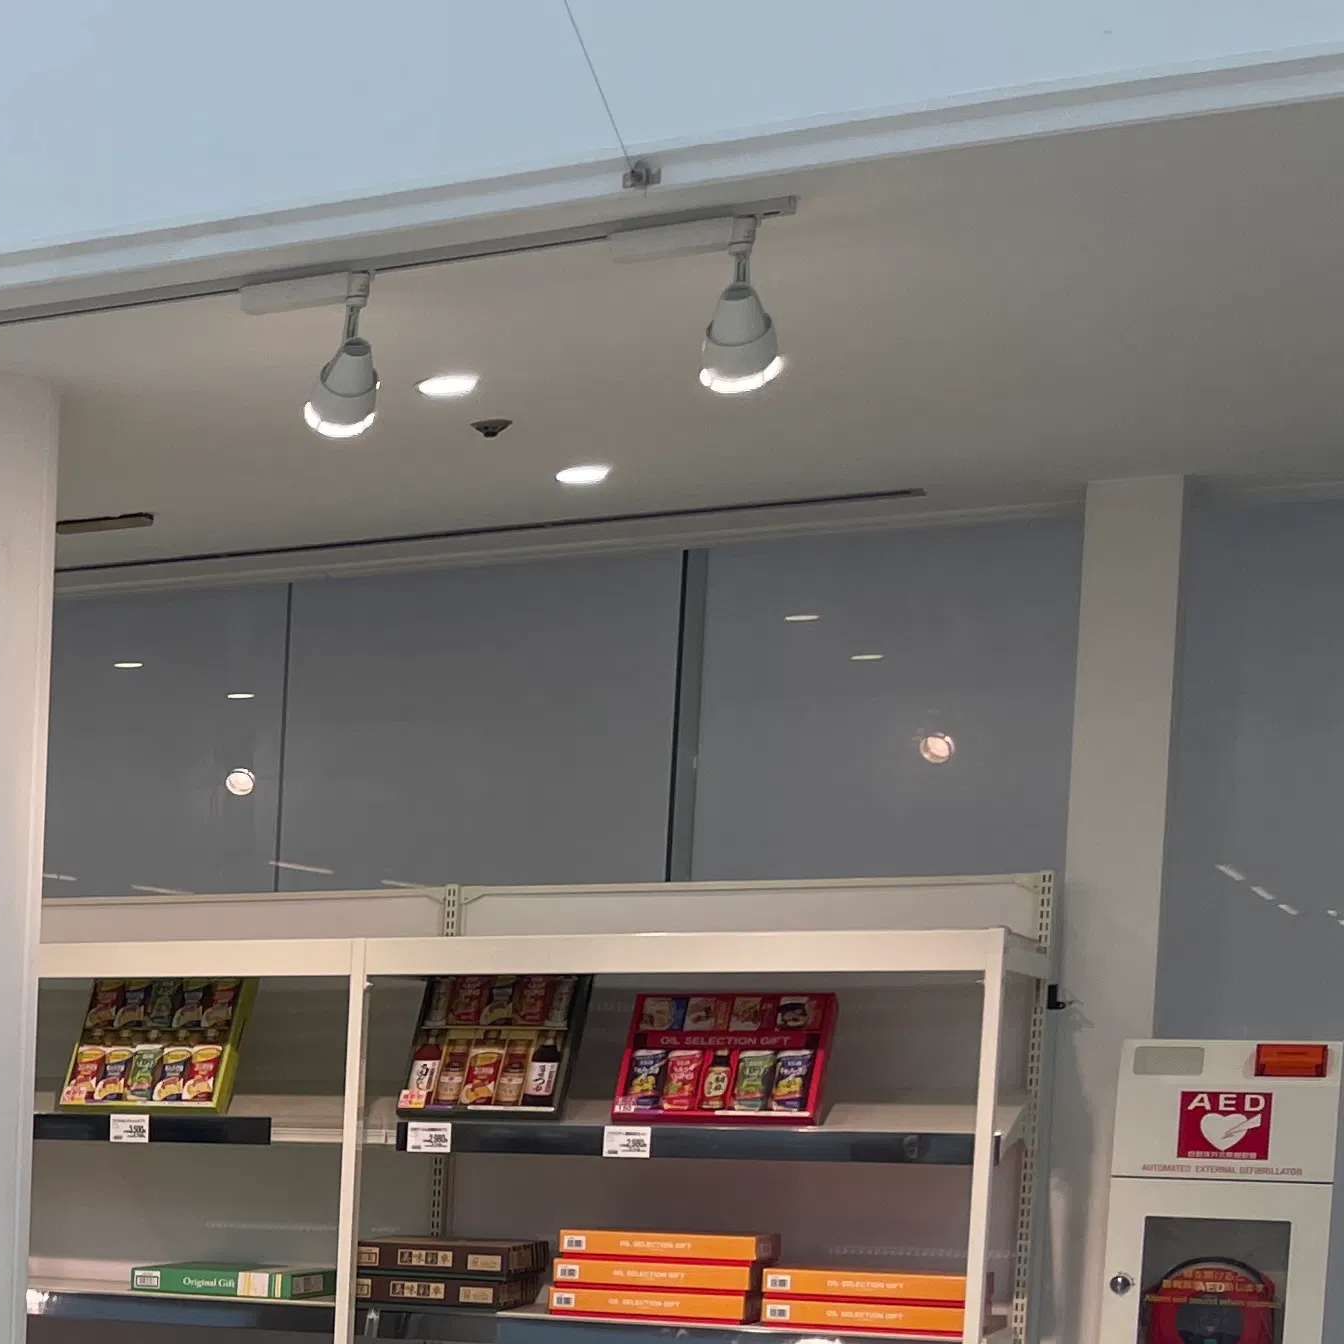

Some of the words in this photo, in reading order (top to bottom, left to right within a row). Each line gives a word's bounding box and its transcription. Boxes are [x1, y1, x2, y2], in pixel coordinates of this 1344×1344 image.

[660, 1036, 681, 1046] OIL
[684, 1036, 758, 1046] SELECTION
[760, 1036, 791, 1046] GIFT
[1187, 1093, 1266, 1112] AED
[1141, 1163, 1191, 1173] AUTOMATED
[1195, 1165, 1237, 1174] EXTERNAL
[1239, 1166, 1303, 1176] DEFIBRILLATOR
[182, 1276, 217, 1288] Original
[218, 1278, 235, 1288] Gift
[1195, 1281, 1225, 1293] AED
